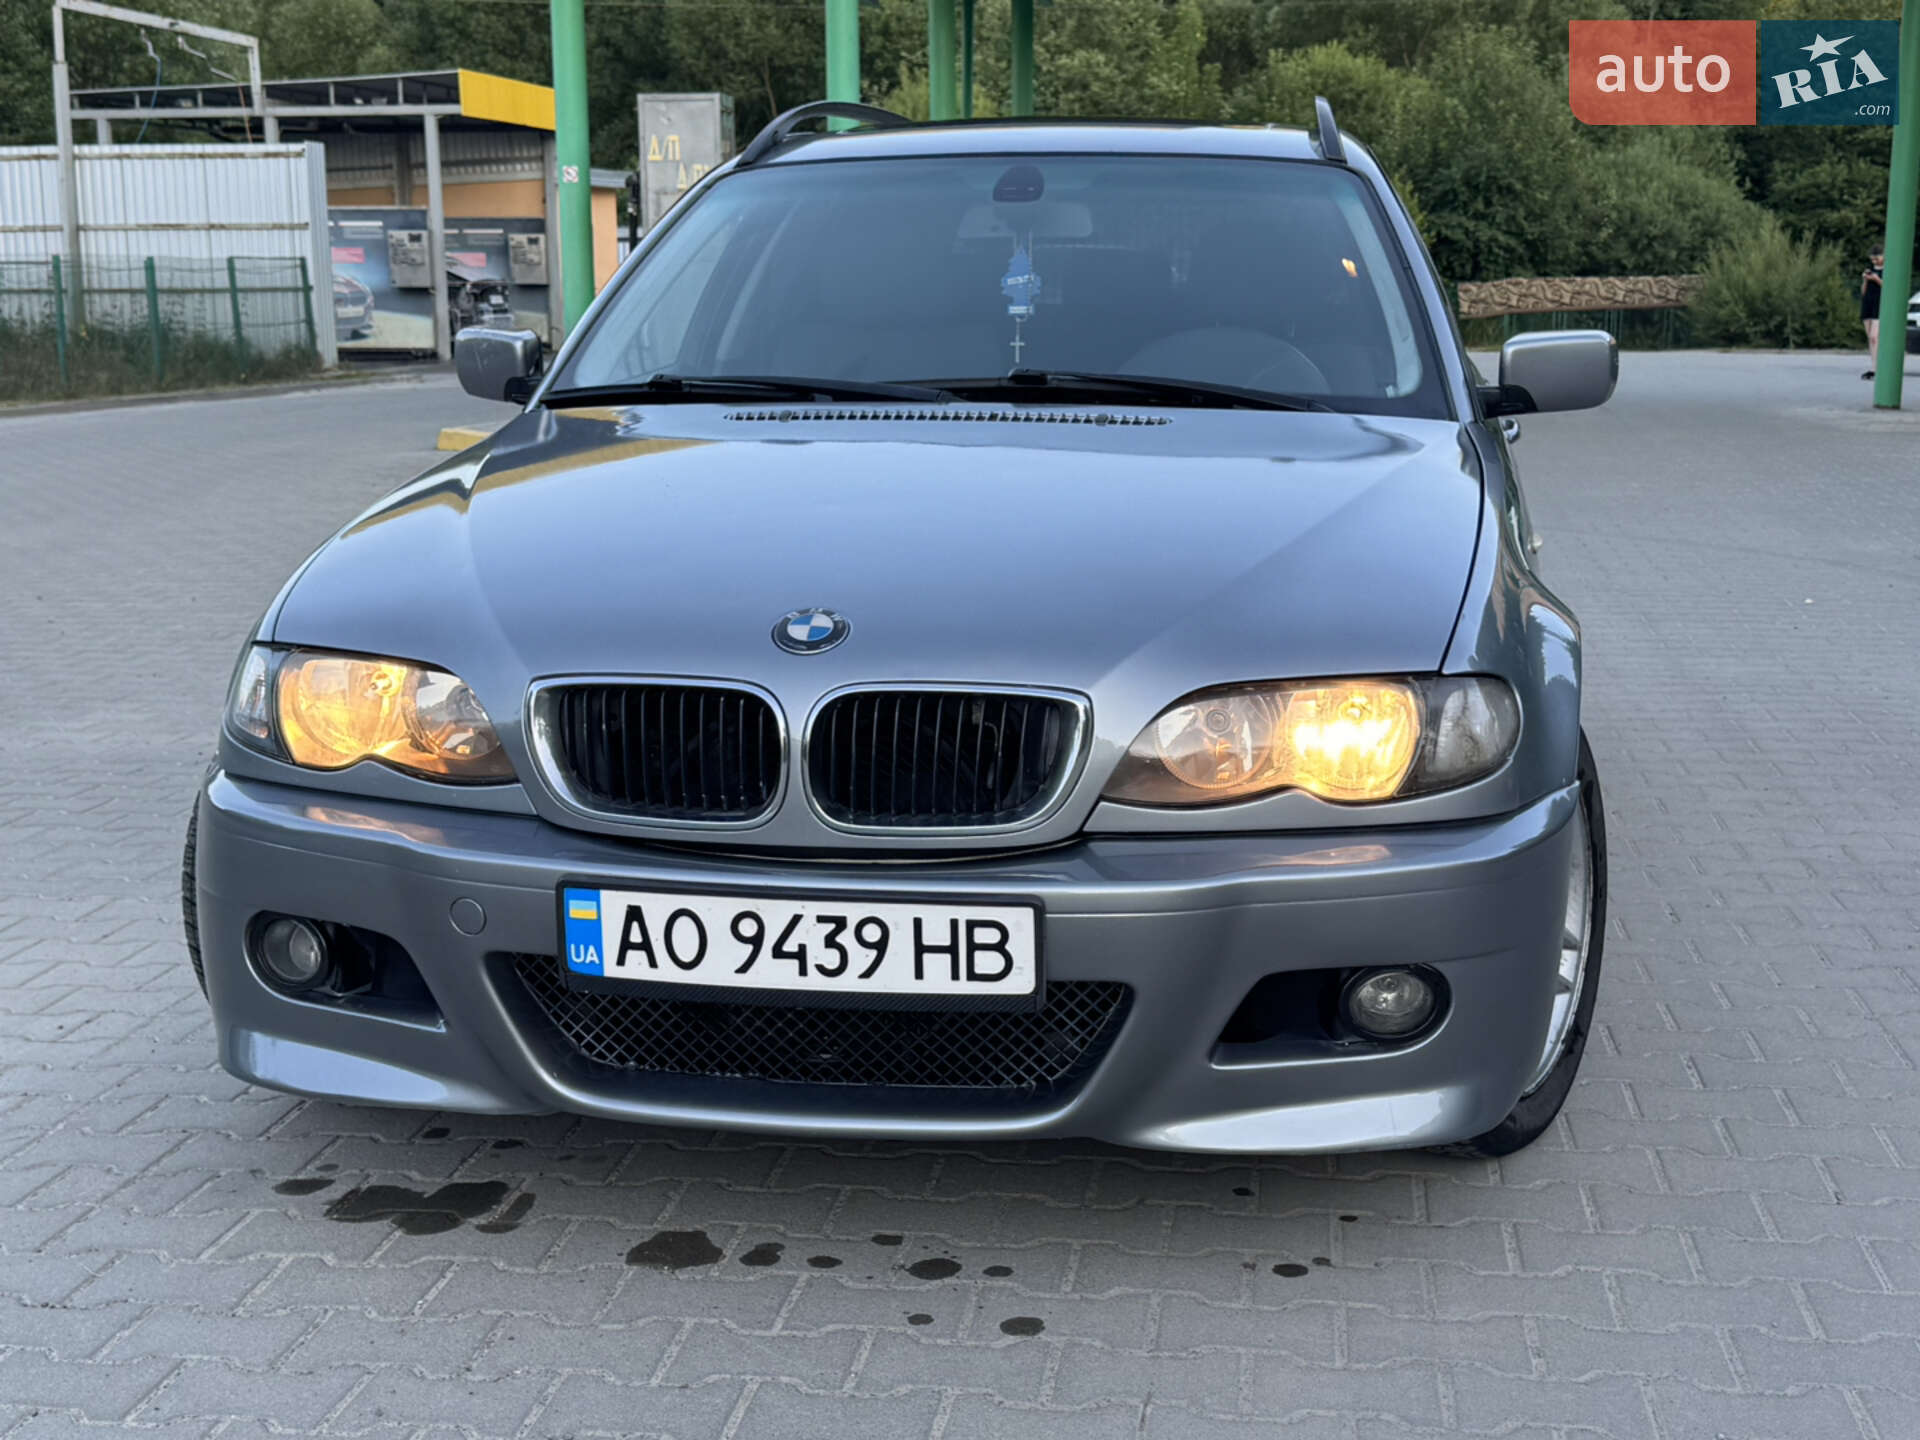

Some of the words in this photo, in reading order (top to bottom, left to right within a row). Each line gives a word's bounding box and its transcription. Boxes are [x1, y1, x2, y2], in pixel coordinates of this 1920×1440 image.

[570, 944, 600, 964] UA
[616, 904, 708, 971] AO
[730, 910, 890, 979] 9439
[913, 917, 1014, 982] HB
